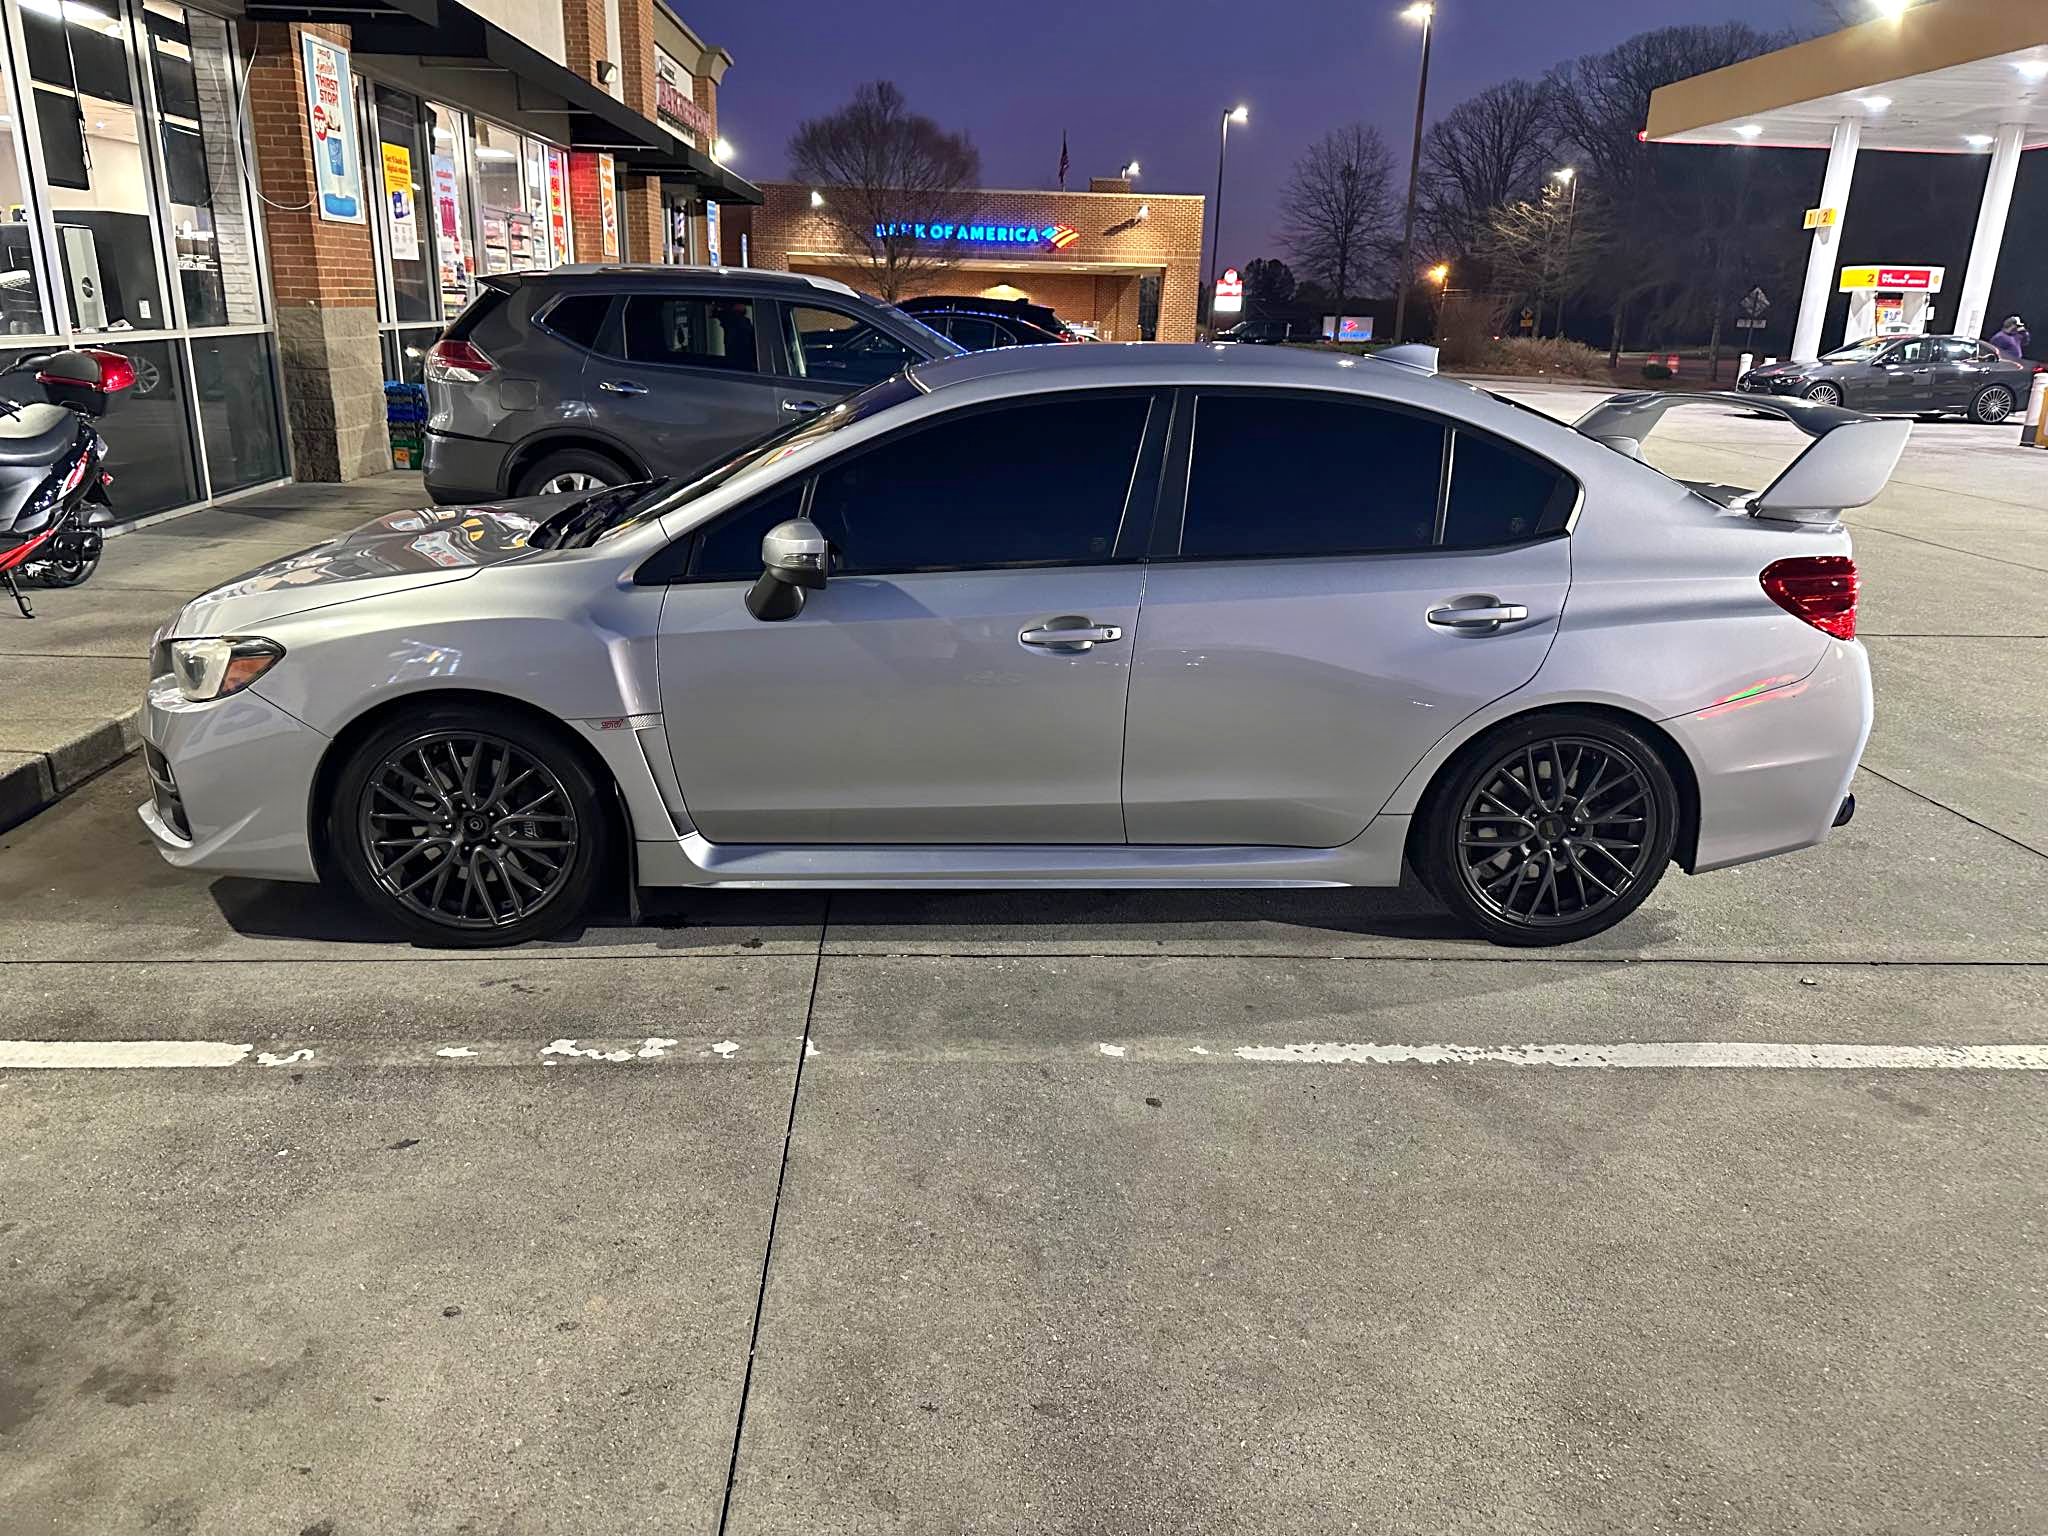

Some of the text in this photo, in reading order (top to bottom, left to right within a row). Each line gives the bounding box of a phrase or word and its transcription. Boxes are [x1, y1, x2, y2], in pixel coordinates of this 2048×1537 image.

[930, 224, 954, 239] OF
[956, 223, 1039, 242] AMERICA
[1867, 273, 1875, 283] 2
